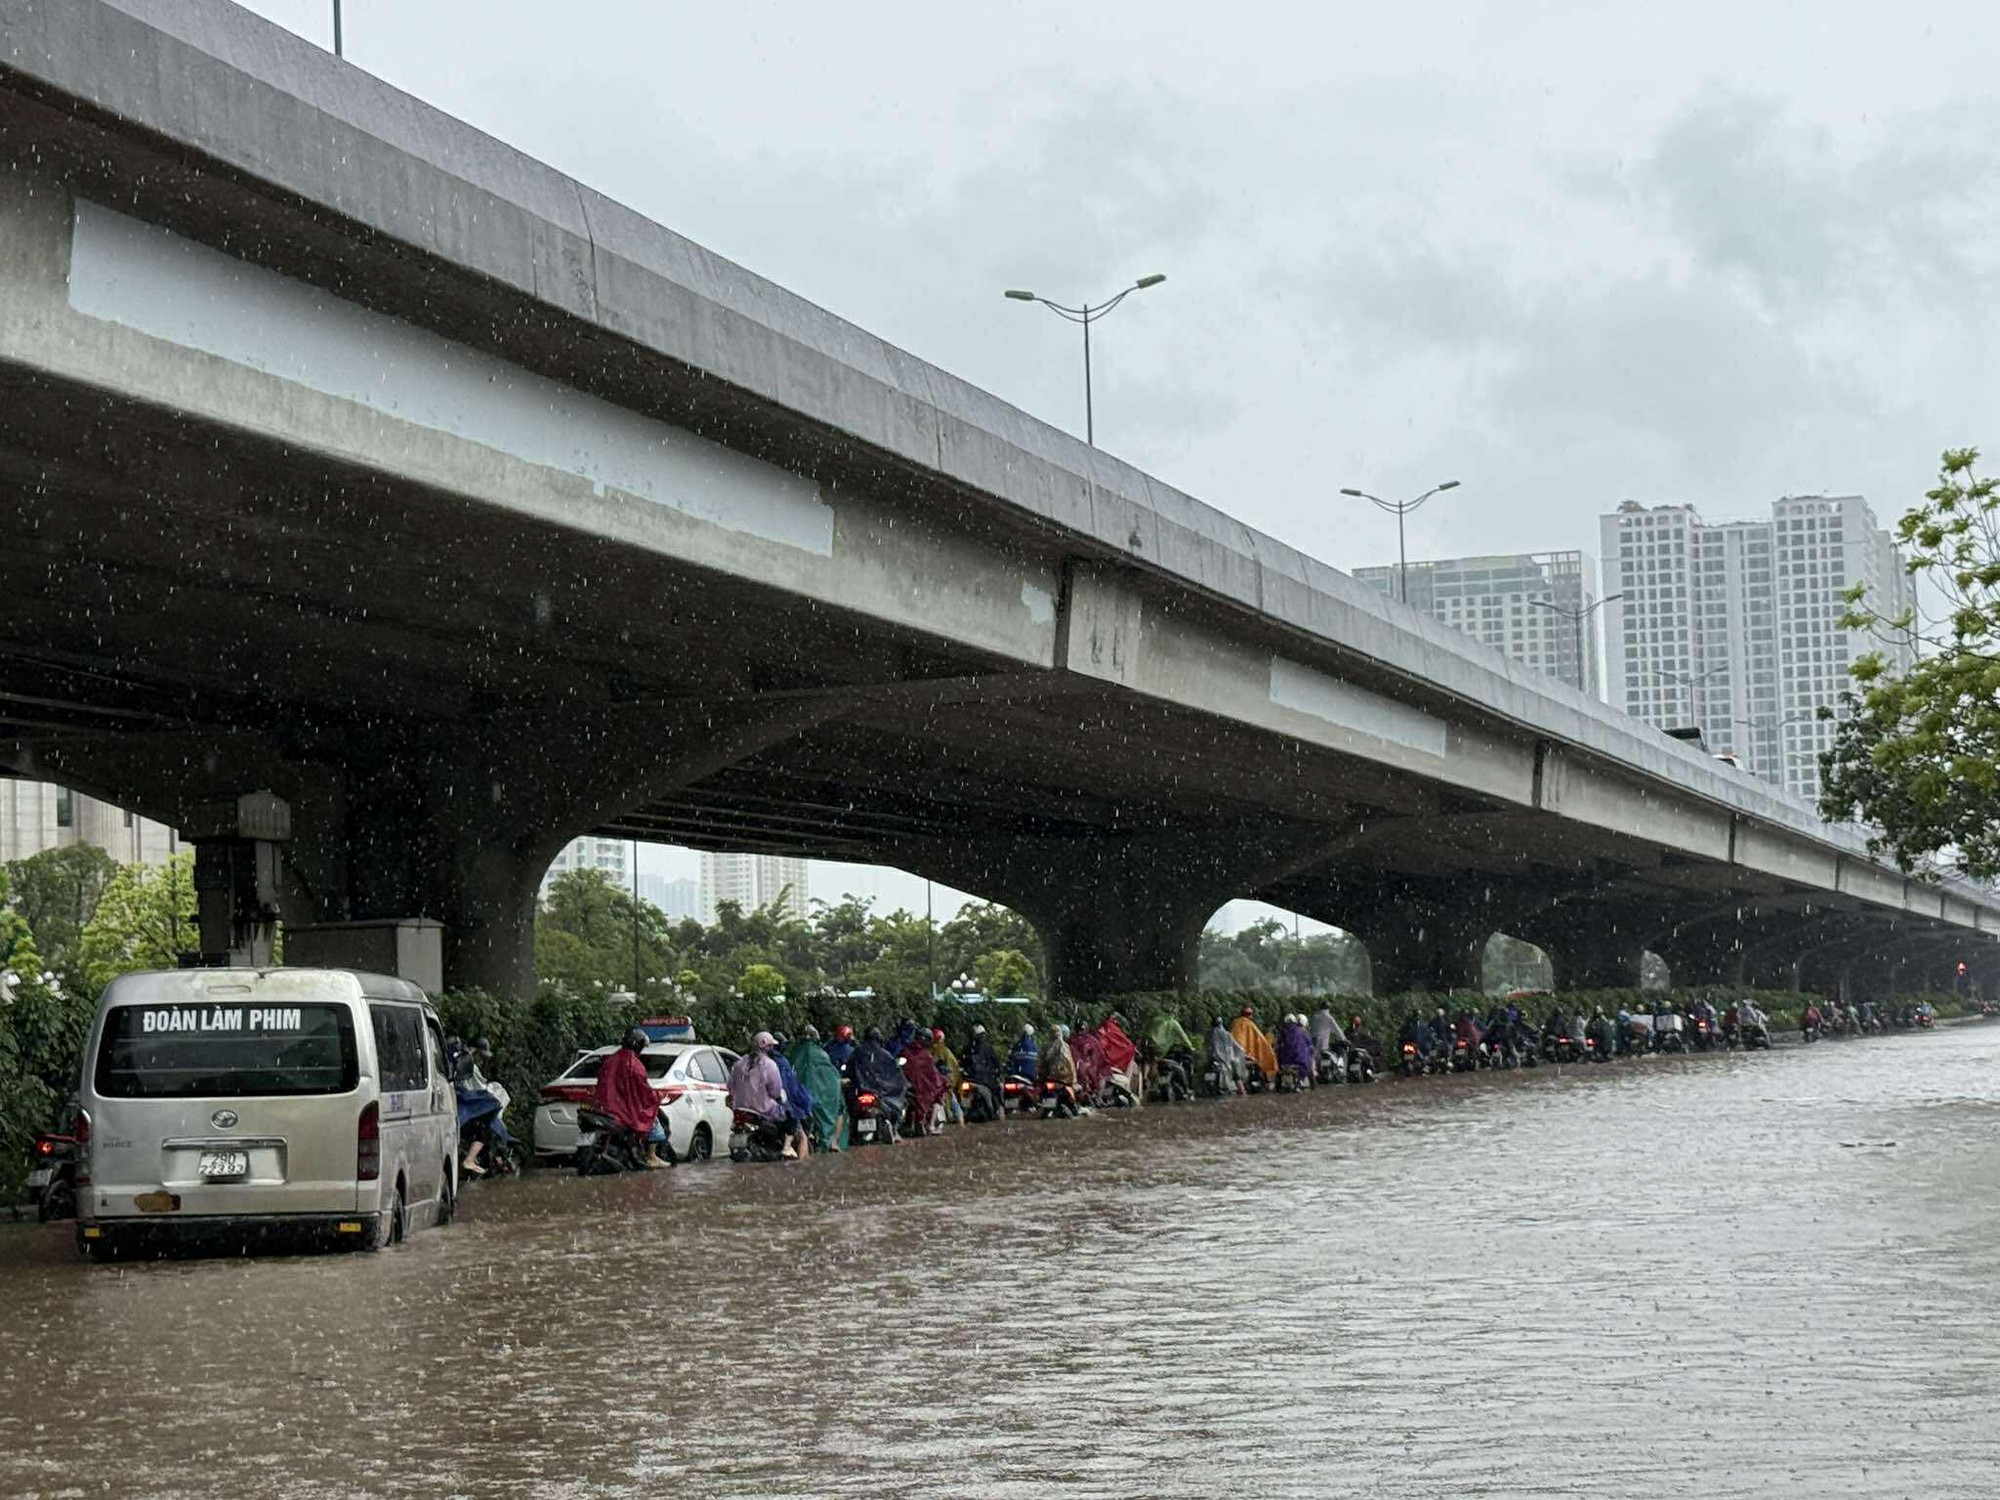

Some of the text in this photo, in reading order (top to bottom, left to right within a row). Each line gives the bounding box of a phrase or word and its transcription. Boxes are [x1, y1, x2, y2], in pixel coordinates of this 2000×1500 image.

[143, 1005, 301, 1032] ĐOÀN LÀM PHIM
